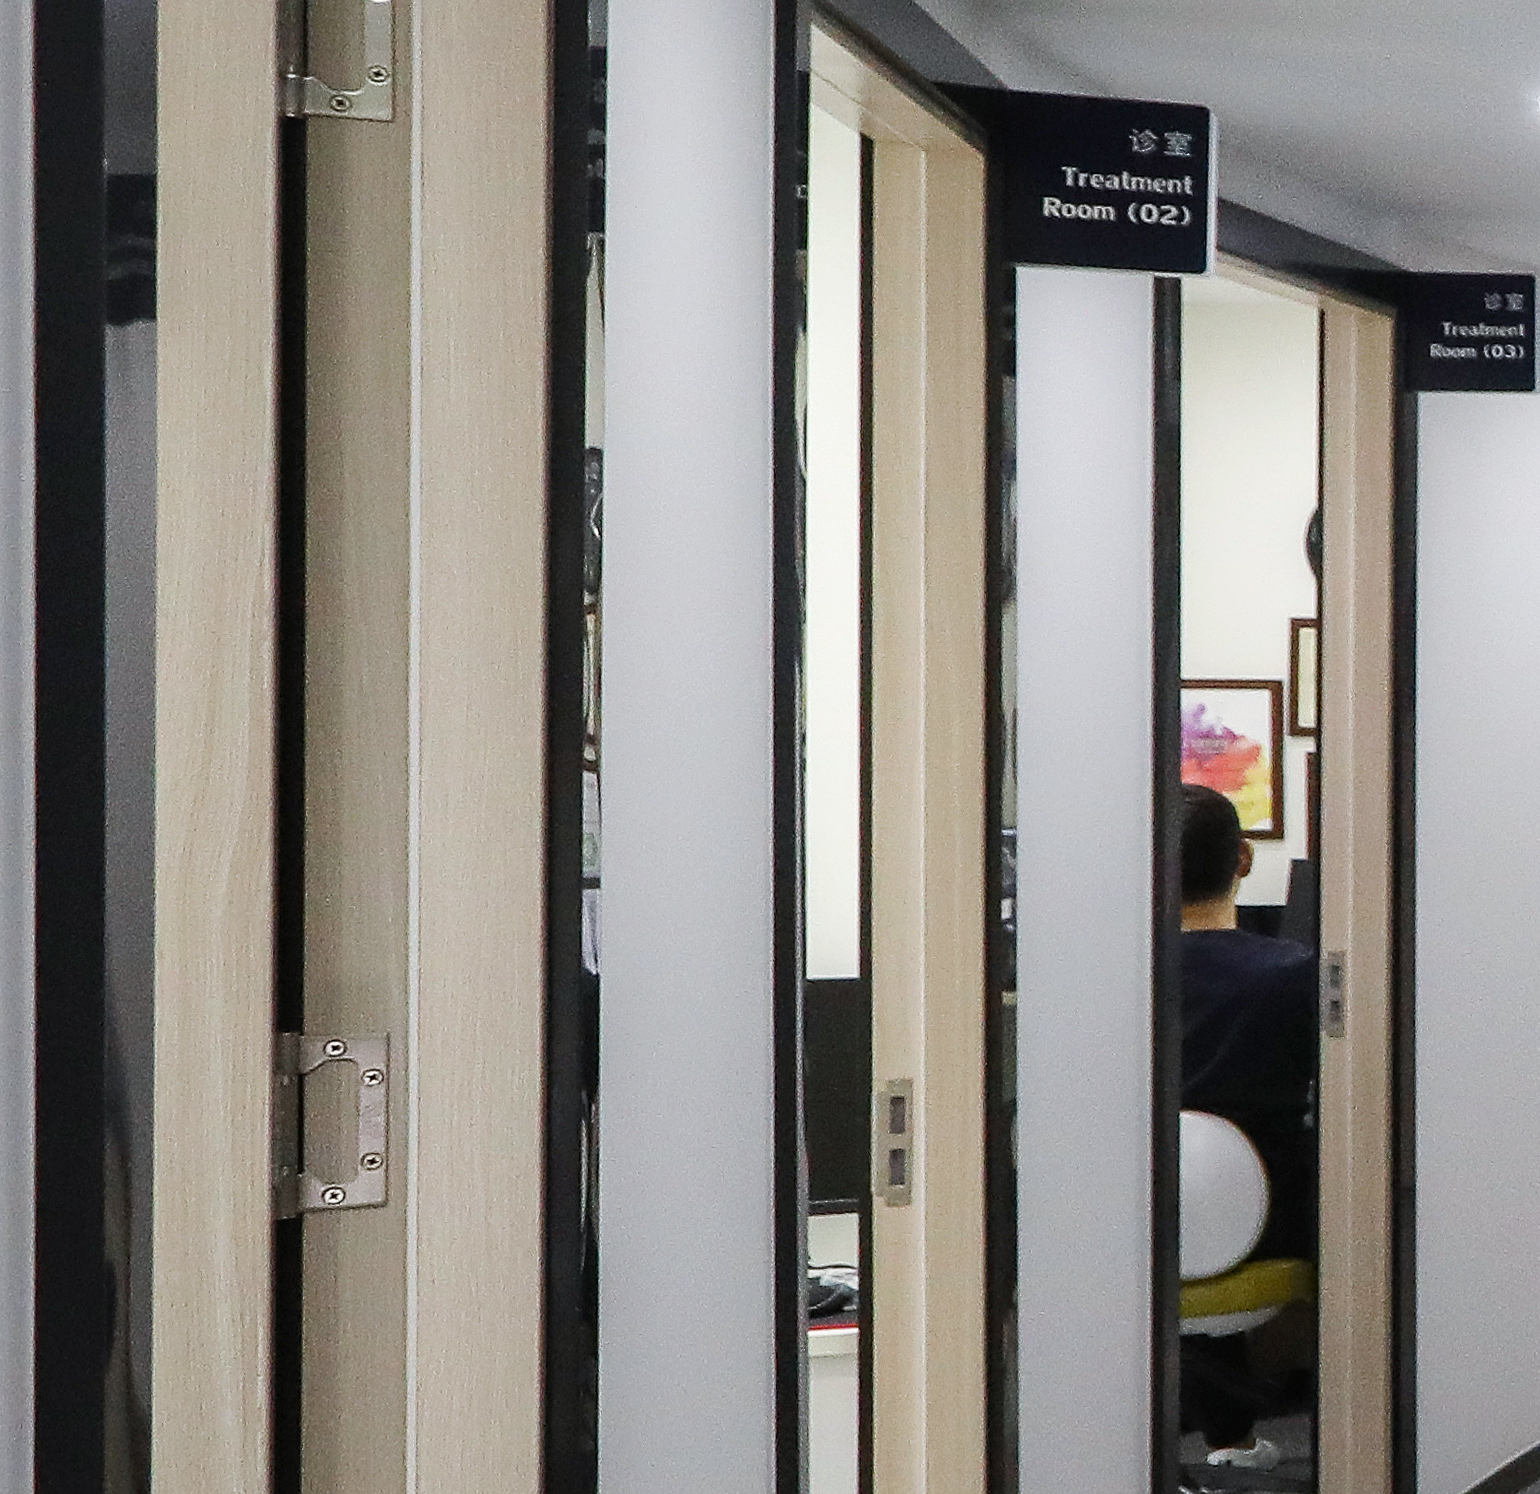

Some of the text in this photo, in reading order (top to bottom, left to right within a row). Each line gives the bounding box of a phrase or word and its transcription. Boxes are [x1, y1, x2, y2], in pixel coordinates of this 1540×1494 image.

[1129, 128, 1193, 156] 诊室
[1060, 165, 1194, 197] Treatment
[1042, 196, 1192, 227] Room (02)
[1441, 321, 1525, 337] Treatment
[1429, 343, 1524, 358] Room (03)
